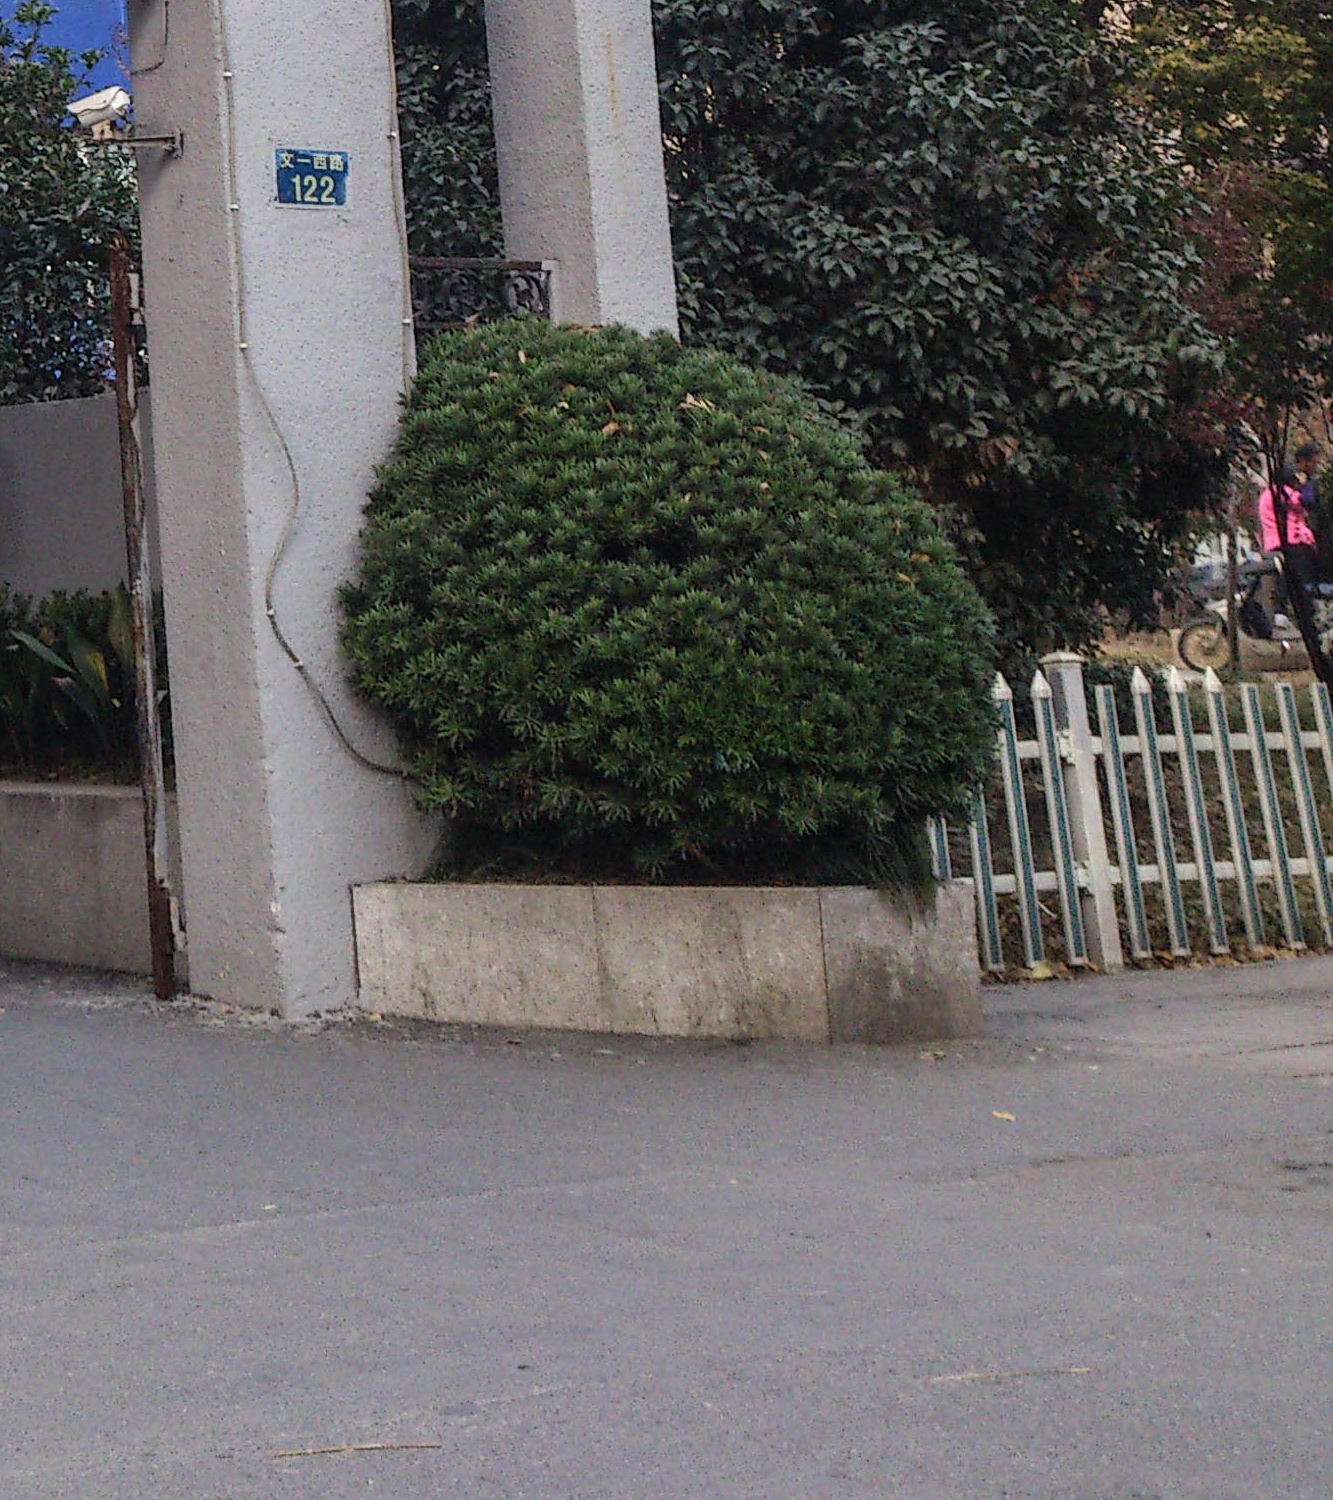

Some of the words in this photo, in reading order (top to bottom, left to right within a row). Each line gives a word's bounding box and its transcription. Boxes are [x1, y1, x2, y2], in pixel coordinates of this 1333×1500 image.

[279, 152, 345, 172] 文一西路
[291, 173, 336, 204] 122
